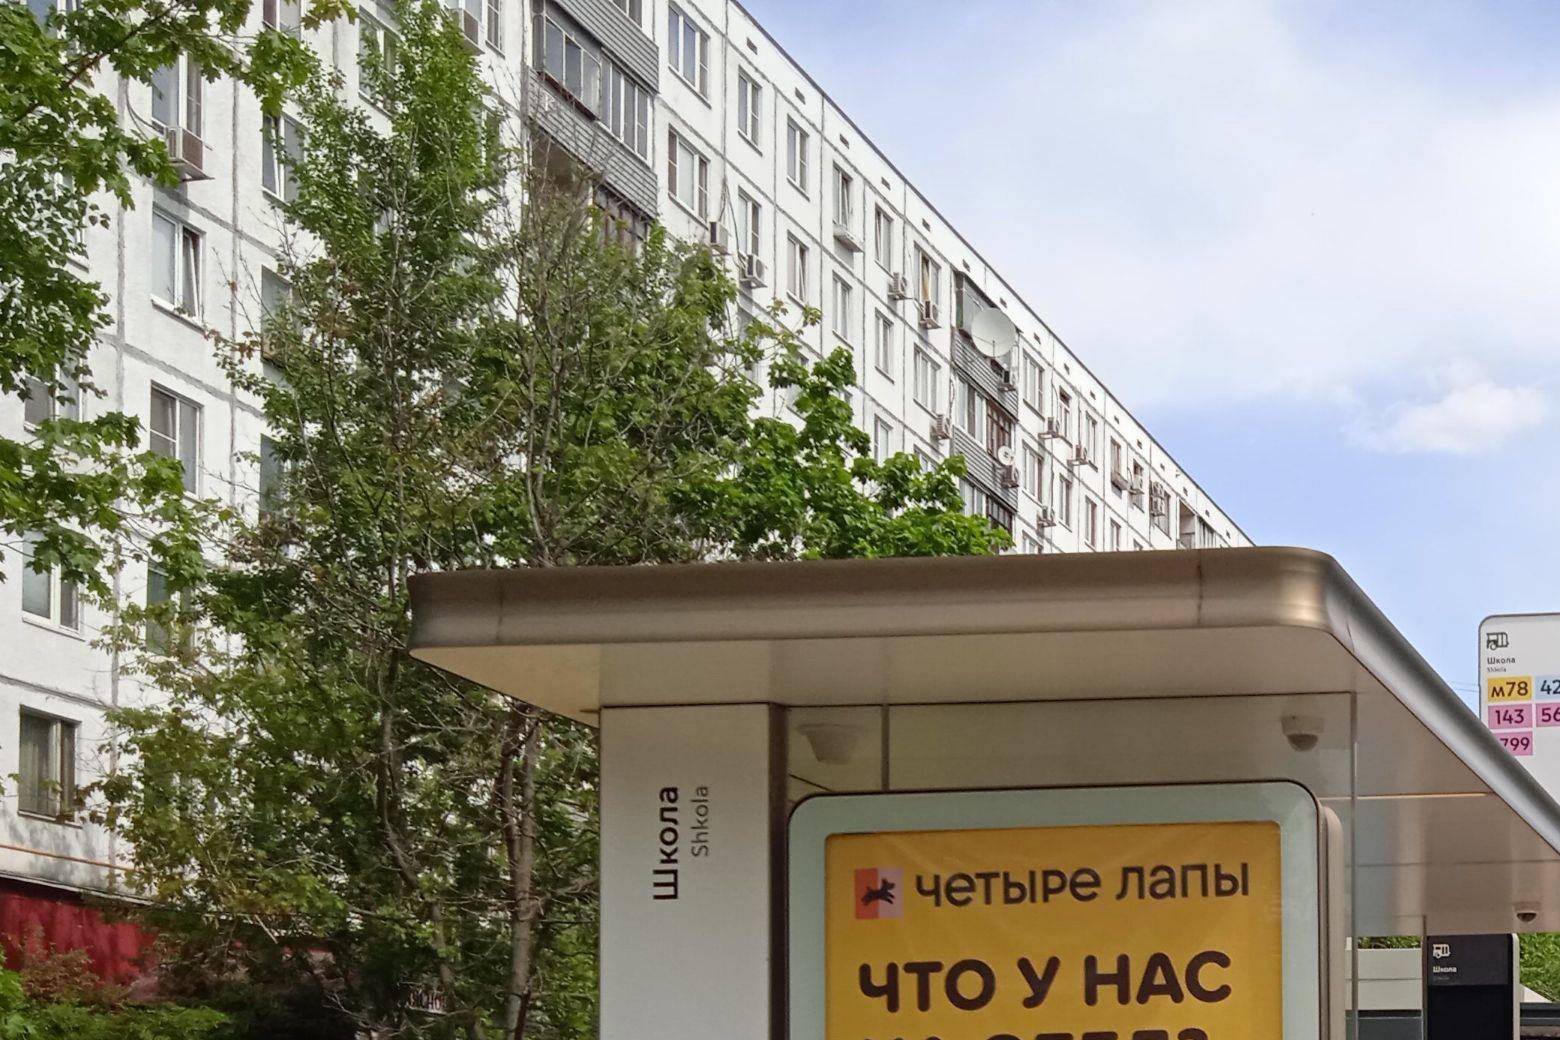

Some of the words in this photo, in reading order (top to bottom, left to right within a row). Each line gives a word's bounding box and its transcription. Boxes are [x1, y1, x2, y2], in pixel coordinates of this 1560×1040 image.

[1487, 656, 1516, 664] Школа
[1495, 710, 1524, 725] 143
[652, 787, 679, 900] Школа
[690, 786, 709, 857] Shkola
[916, 865, 1100, 907] четыре
[1116, 861, 1250, 900] лапы
[859, 959, 994, 1013] ЧТО
[1019, 956, 1060, 1008] У
[1084, 950, 1232, 1005] НАС
